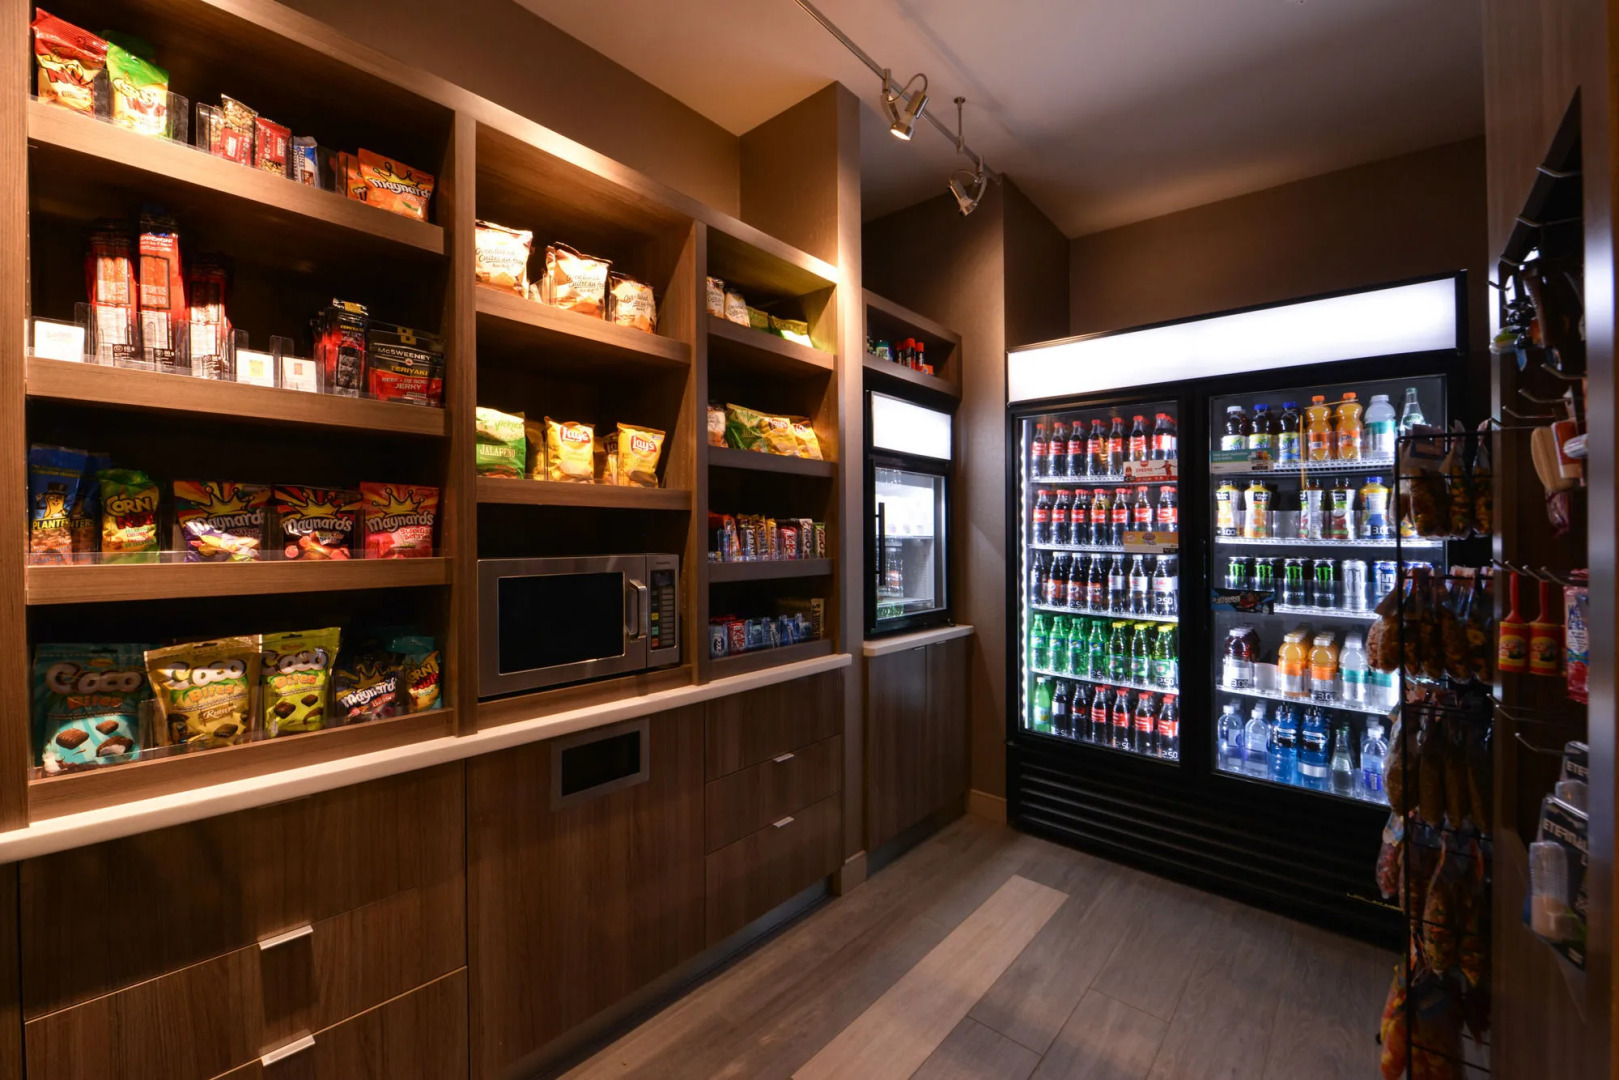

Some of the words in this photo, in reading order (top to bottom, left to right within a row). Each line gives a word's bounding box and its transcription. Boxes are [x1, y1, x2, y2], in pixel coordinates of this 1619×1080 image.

[391, 365, 428, 376] TERIYAKI
[395, 381, 422, 390] JERKY
[106, 495, 153, 516] CORN
[46, 662, 145, 695] Coco
[275, 673, 317, 688] Bites
[187, 683, 235, 702] Bites
[1162, 751, 1178, 760] 2.50
